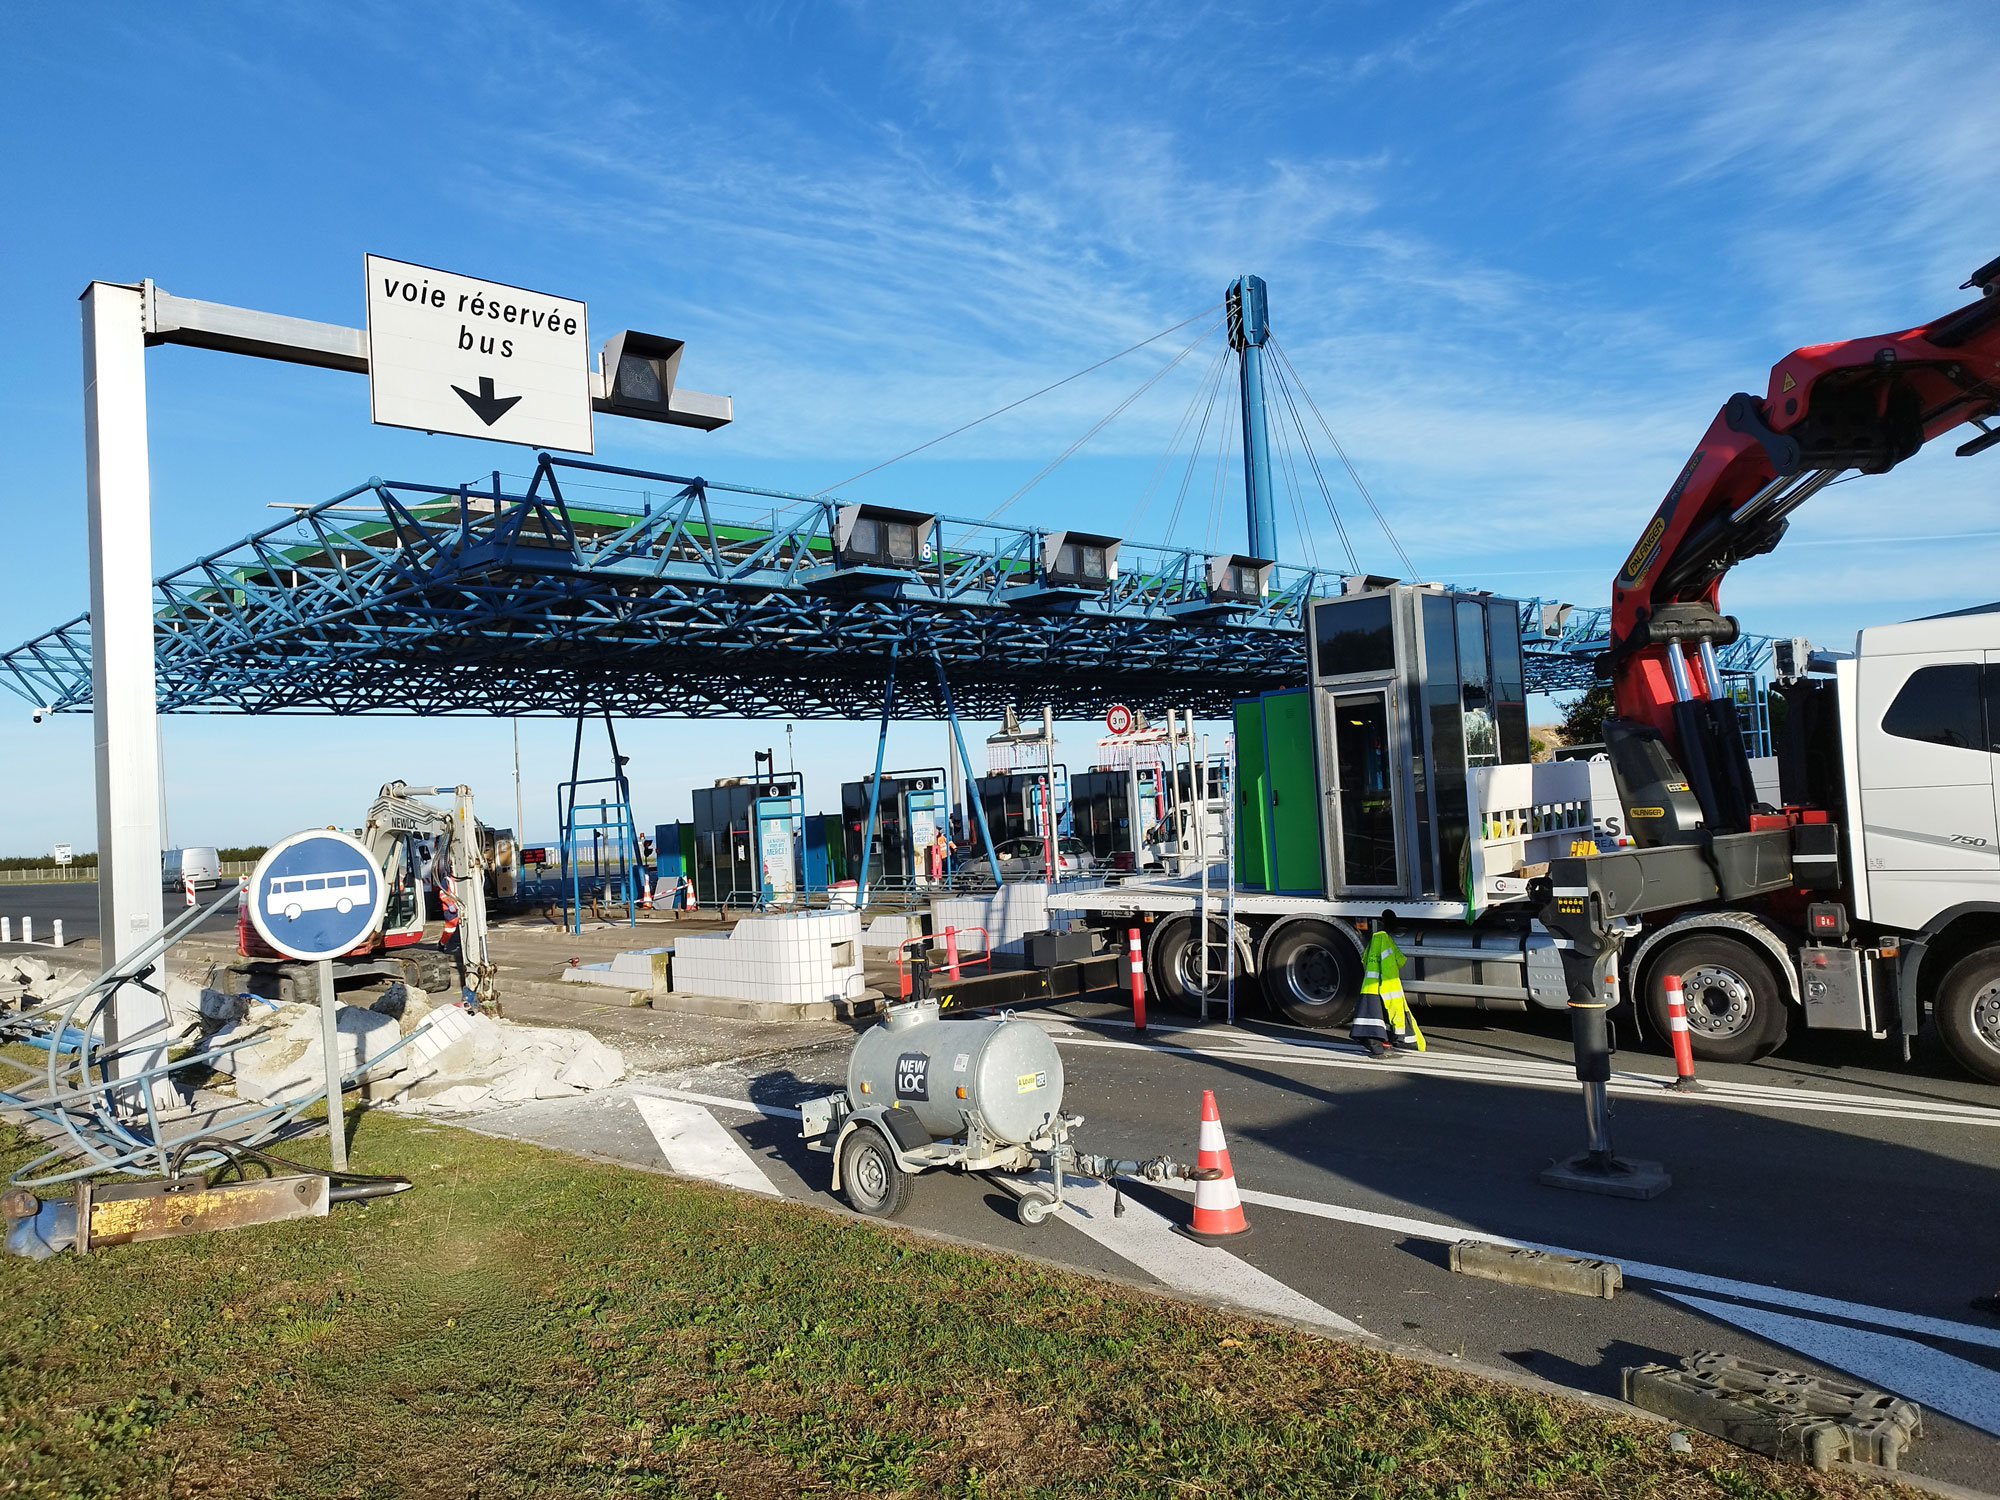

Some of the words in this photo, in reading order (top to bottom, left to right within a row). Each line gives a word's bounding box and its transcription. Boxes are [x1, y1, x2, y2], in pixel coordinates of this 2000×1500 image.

[384, 278, 446, 308] voie
[458, 291, 577, 335] réservée
[458, 325, 514, 358] bus
[923, 543, 931, 559] 8
[1629, 521, 1663, 573] PALFINGER
[771, 787, 777, 795] 6
[1950, 834, 1987, 847] 750
[899, 1059, 927, 1073] NEW
[898, 1073, 925, 1093] LOC
